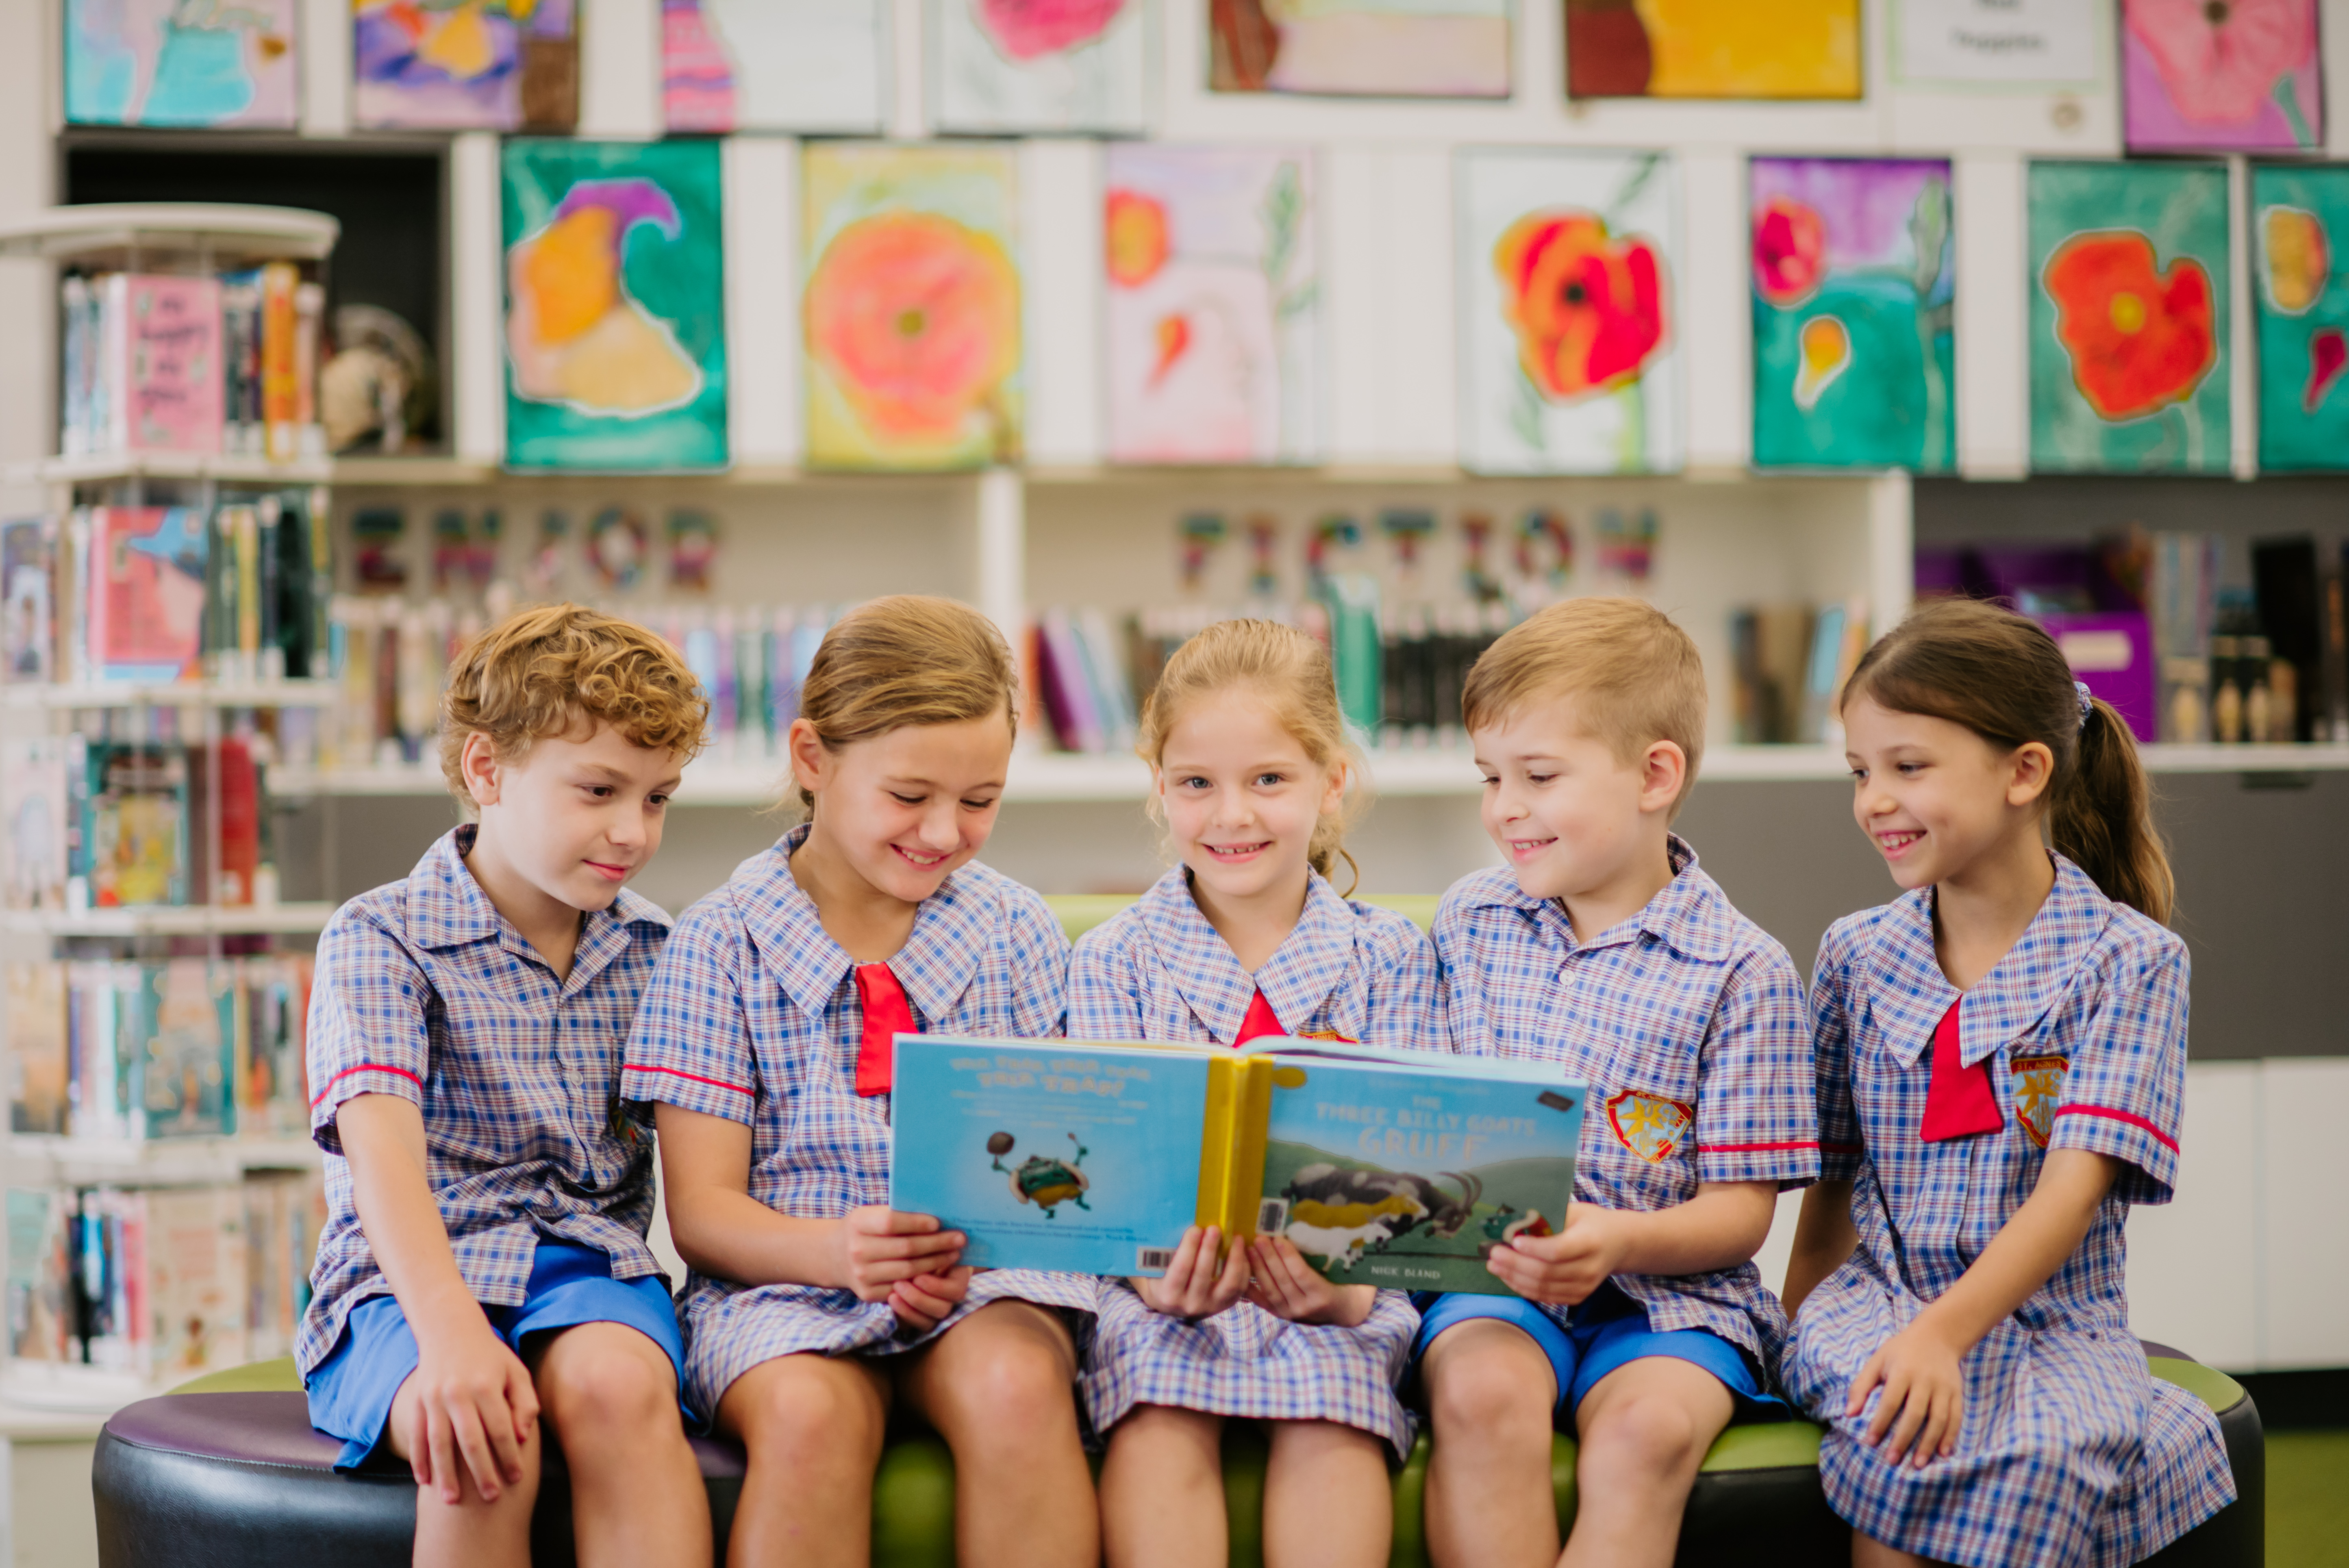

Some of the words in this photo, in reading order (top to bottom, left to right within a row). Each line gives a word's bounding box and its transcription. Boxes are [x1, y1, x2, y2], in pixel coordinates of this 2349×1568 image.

[1177, 507, 1658, 595] FICTION
[2035, 1060, 2061, 1068] AGNES
[1412, 1095, 1441, 1110] THE
[1315, 1101, 1389, 1126] THREE
[1397, 1108, 1460, 1130] BILLY
[1466, 1114, 1537, 1136] GOATS
[1358, 1126, 1488, 1161] GRUFF
[1371, 1265, 1398, 1276] NICK
[1404, 1268, 1441, 1279] BLAND
